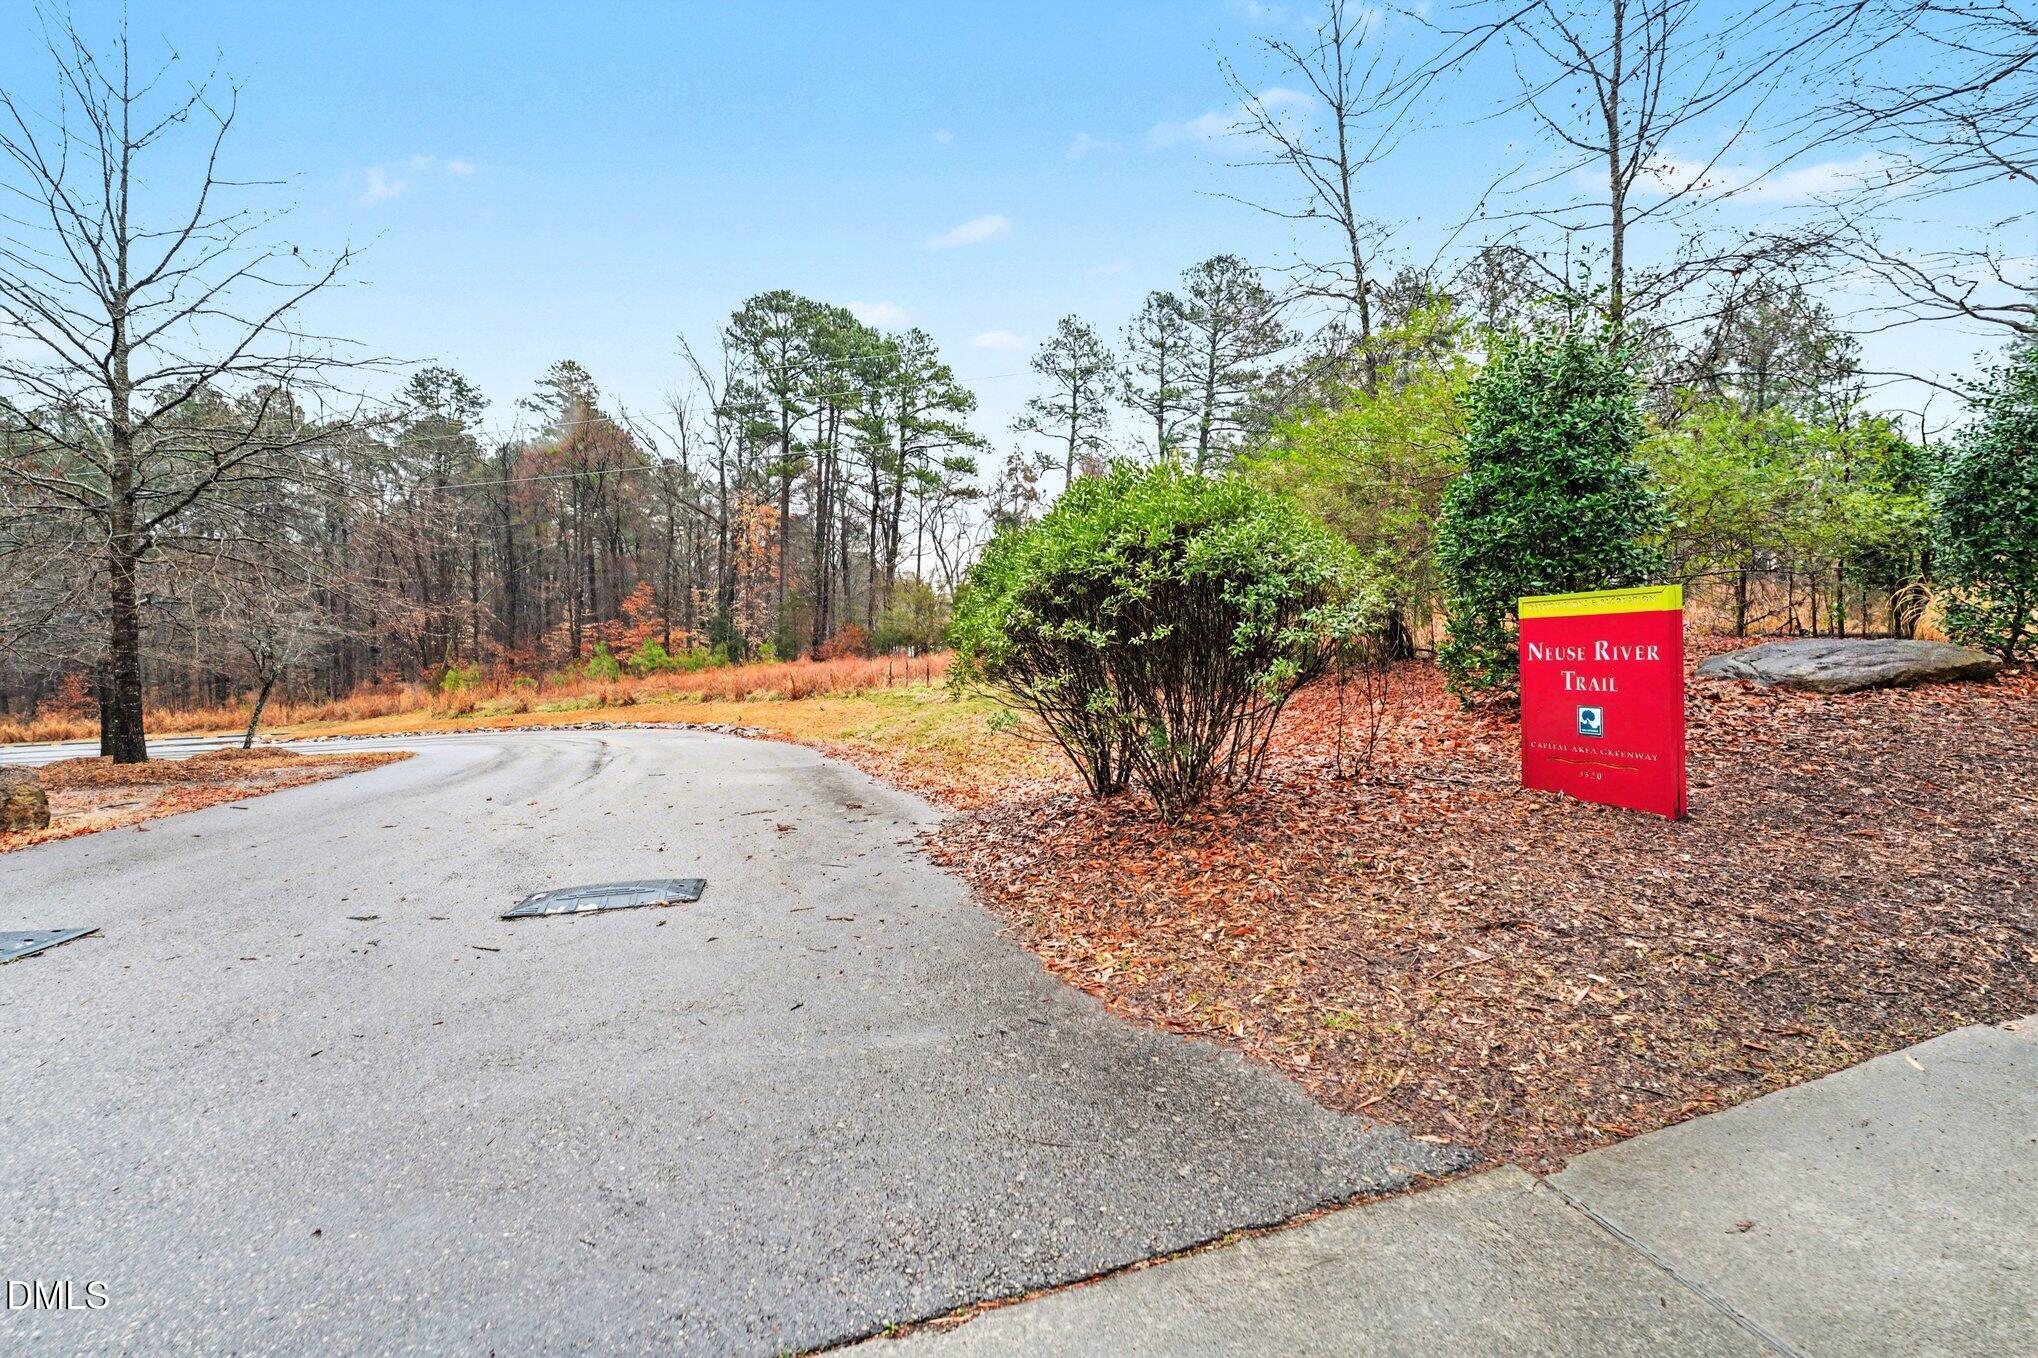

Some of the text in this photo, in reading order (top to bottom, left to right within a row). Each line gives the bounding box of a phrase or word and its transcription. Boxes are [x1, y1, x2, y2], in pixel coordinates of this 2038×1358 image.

[1528, 640, 1660, 661] NEUSE RIVER
[1560, 670, 1619, 692] TRAIL
[1530, 741, 1658, 762] CAPITAL AREA GREENWAY
